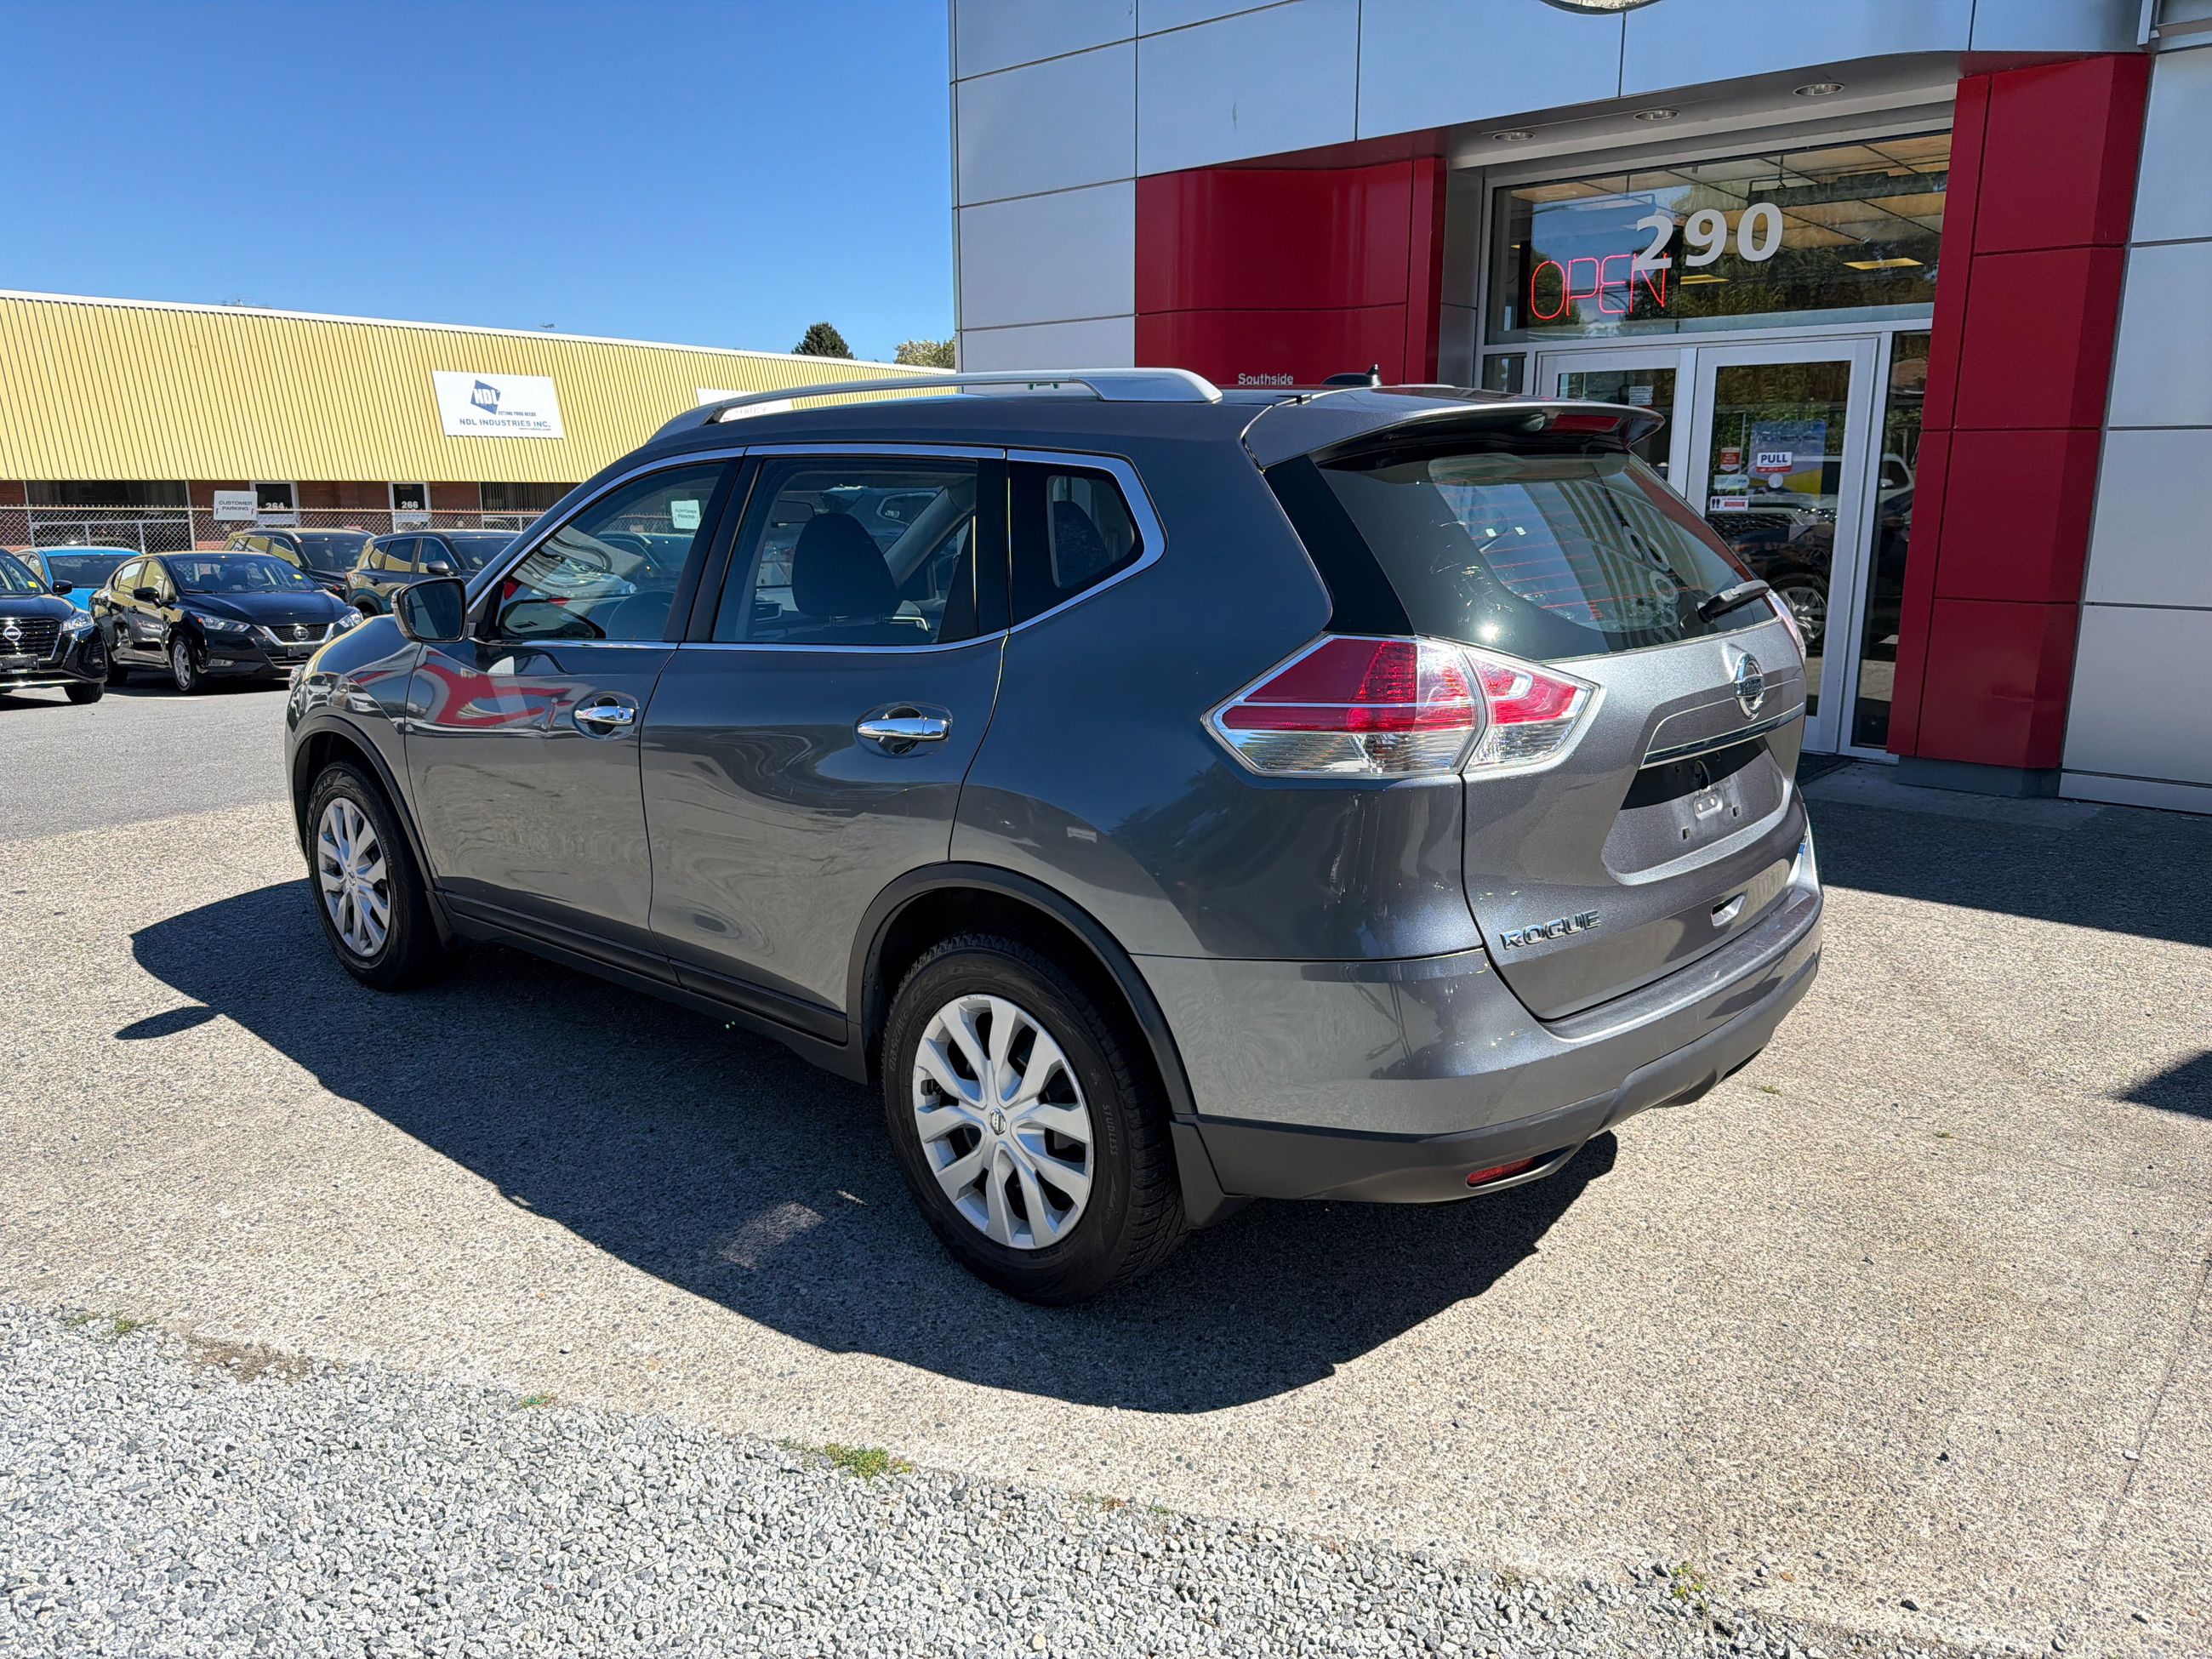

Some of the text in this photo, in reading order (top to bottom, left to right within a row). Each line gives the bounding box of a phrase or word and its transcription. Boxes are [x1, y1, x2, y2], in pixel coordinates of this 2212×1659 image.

[1633, 202, 1784, 272] 290
[1531, 252, 1669, 321] OPEN
[1238, 373, 1294, 385] Southside
[473, 388, 500, 405] NDL
[479, 419, 531, 427] INDUSTRIES
[1760, 453, 1788, 464] PULL
[401, 500, 419, 509] 266
[1499, 909, 1602, 950] ROGUE
[1102, 1103, 1119, 1156] STUDLESS
